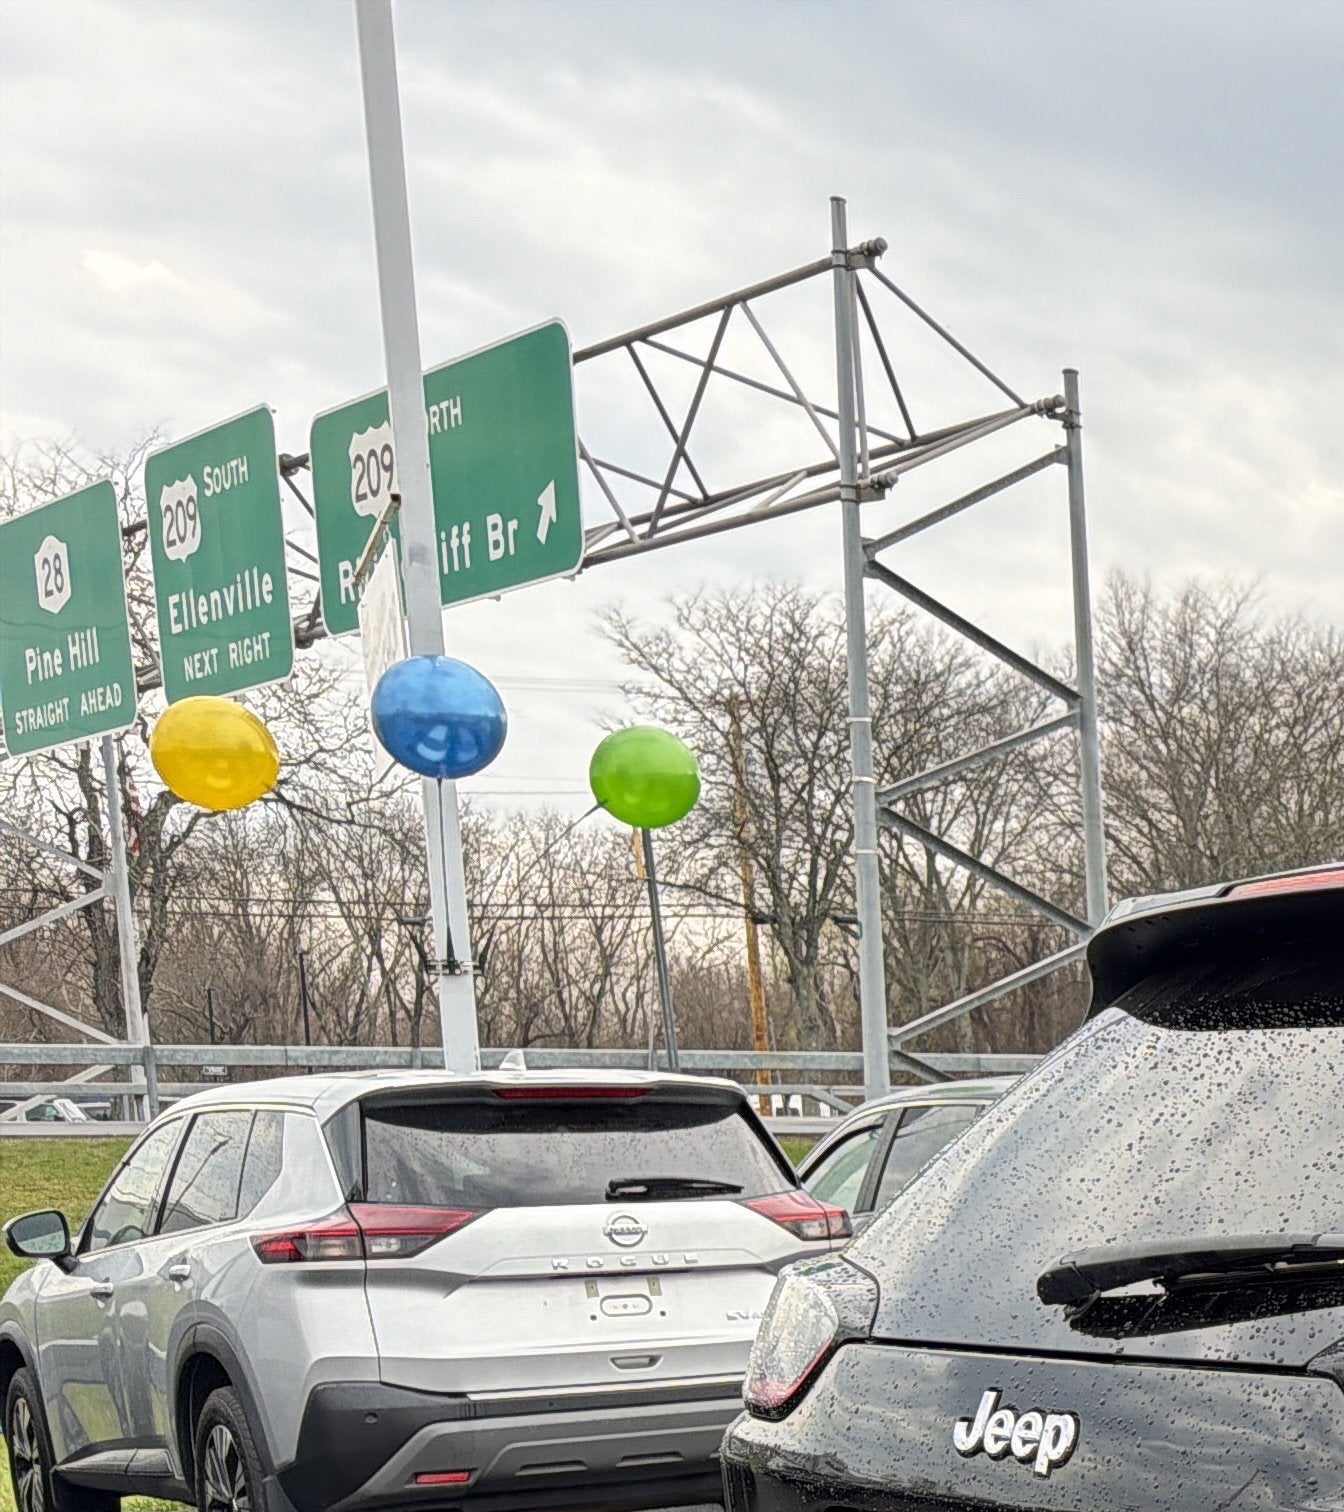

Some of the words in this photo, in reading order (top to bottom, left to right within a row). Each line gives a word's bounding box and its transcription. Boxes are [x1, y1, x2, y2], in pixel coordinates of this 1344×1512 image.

[203, 455, 249, 498] SOUTH
[353, 443, 394, 504] 209
[163, 494, 197, 549] 209
[486, 512, 518, 562] Br
[41, 552, 65, 599] 28
[168, 565, 274, 635] Ellenville
[25, 647, 63, 686] Pine
[67, 626, 100, 672] Hill
[183, 647, 219, 682] NEXT
[228, 631, 271, 669] RIGHT
[15, 697, 70, 735] STRAIGHT
[80, 682, 122, 718] AHEAD
[551, 1252, 700, 1271] ROGUE
[952, 1388, 1077, 1477] Jeep
